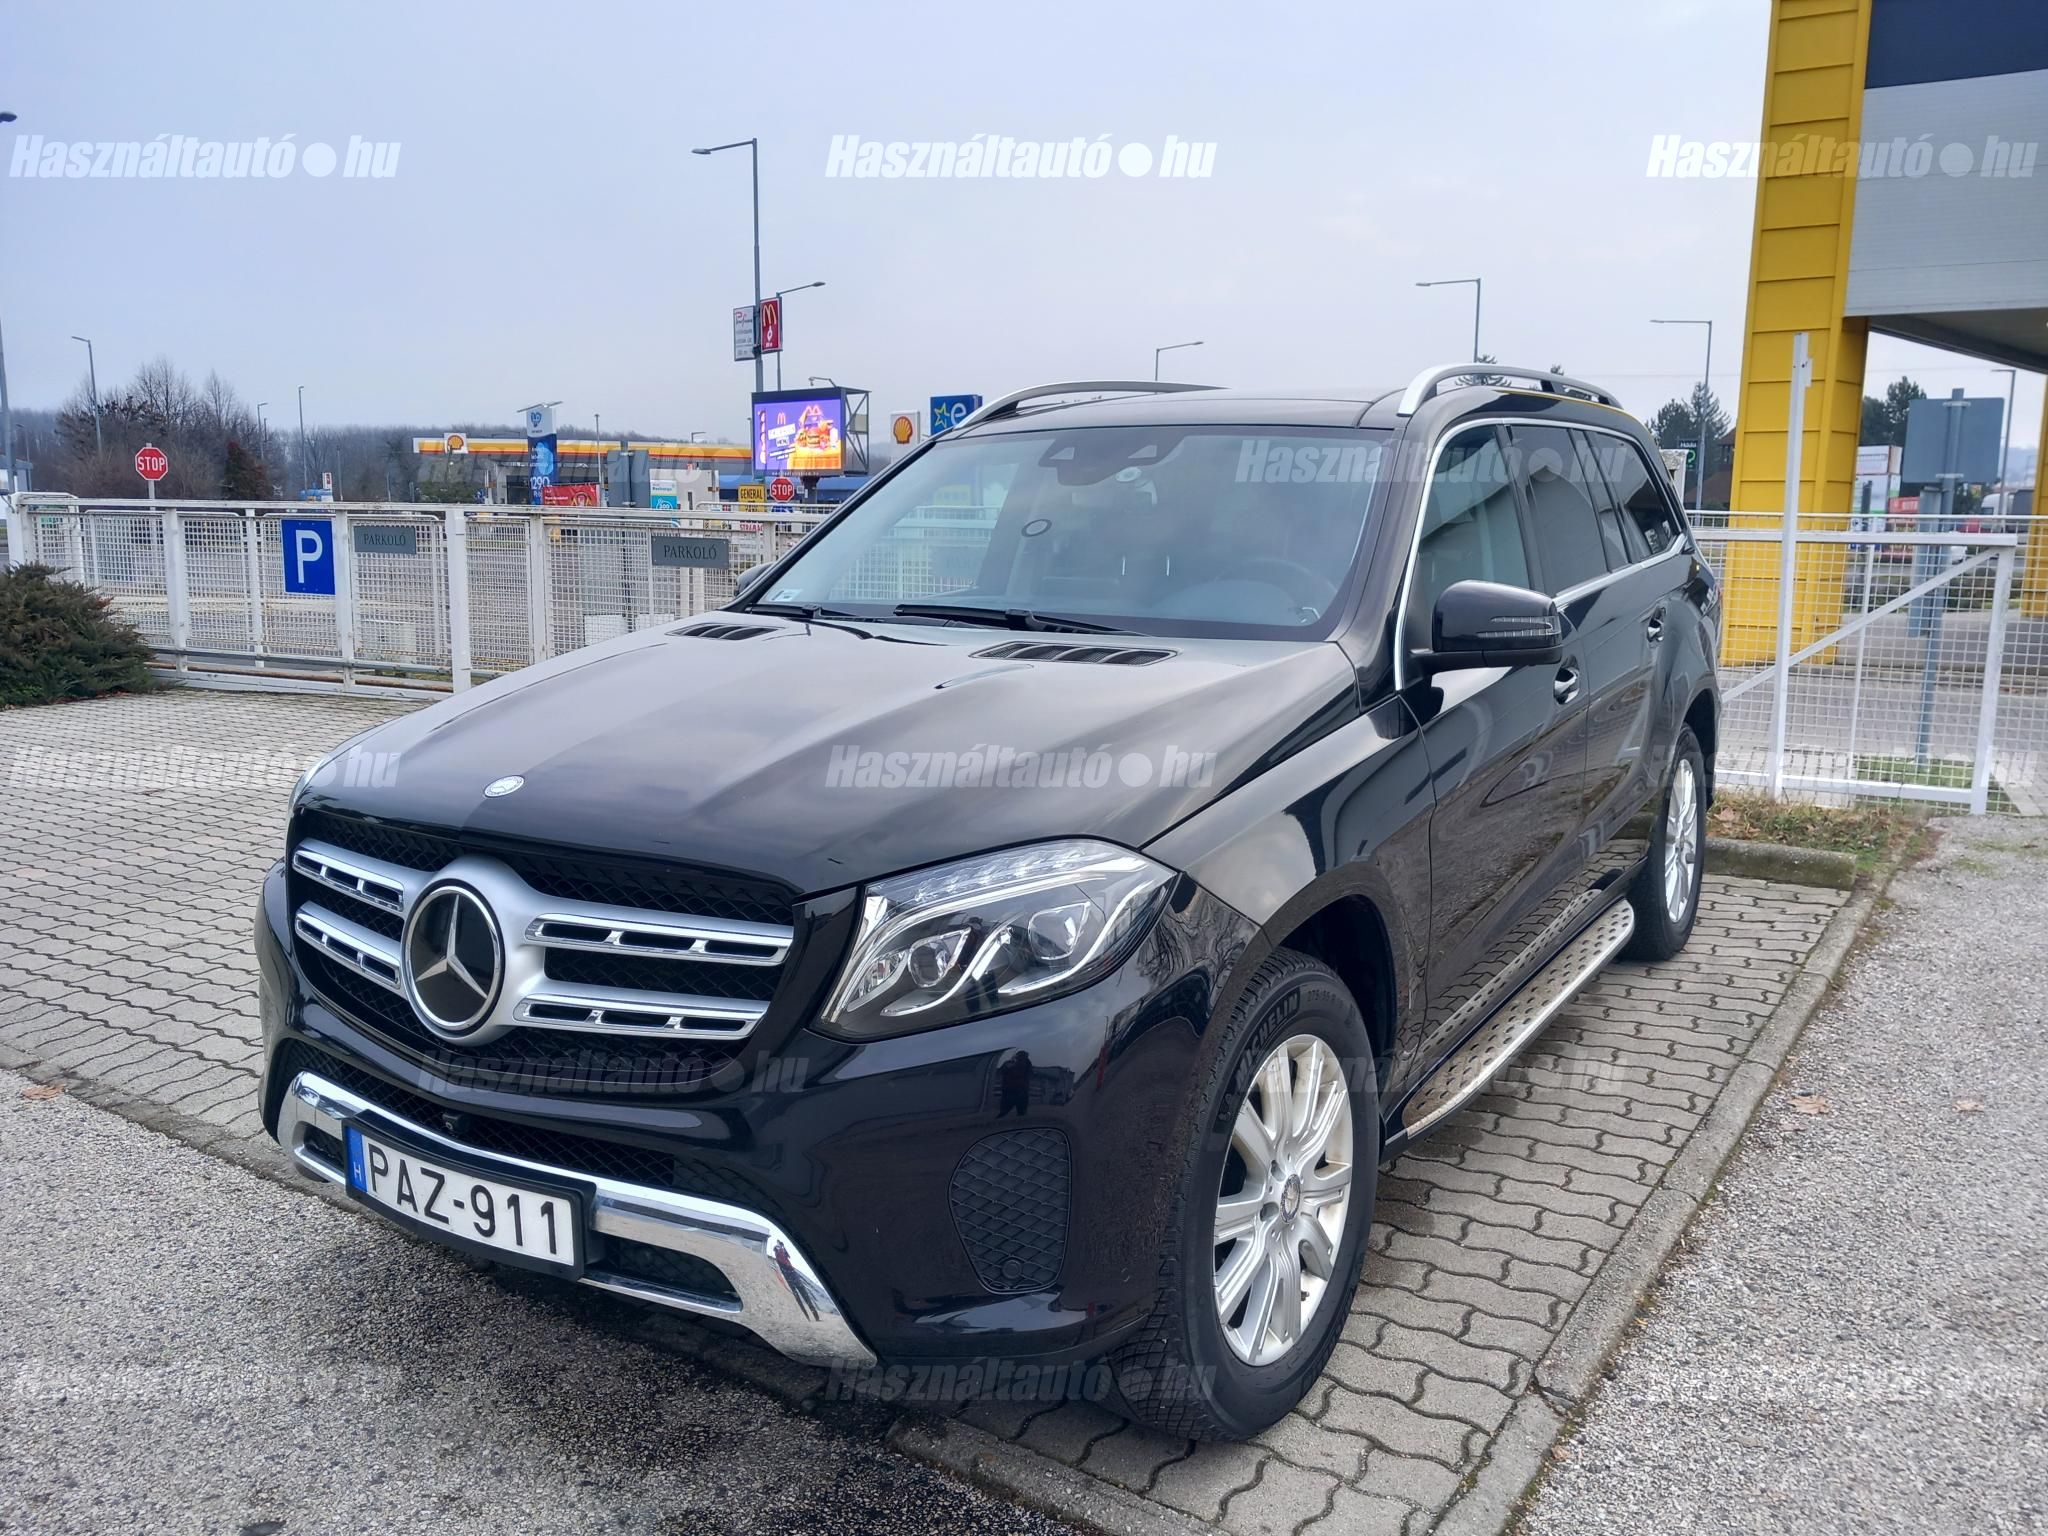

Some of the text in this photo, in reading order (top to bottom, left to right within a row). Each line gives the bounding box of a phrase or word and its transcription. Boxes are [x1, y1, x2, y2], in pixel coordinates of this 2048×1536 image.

[137, 456, 166, 472] STOP
[740, 488, 763, 500] GENERAL
[771, 484, 793, 496] STOP
[363, 531, 406, 546] PARKOLÓ
[295, 529, 323, 584] P
[663, 542, 717, 560] PARKOLÓ
[352, 1142, 558, 1256] H PAZ-911
